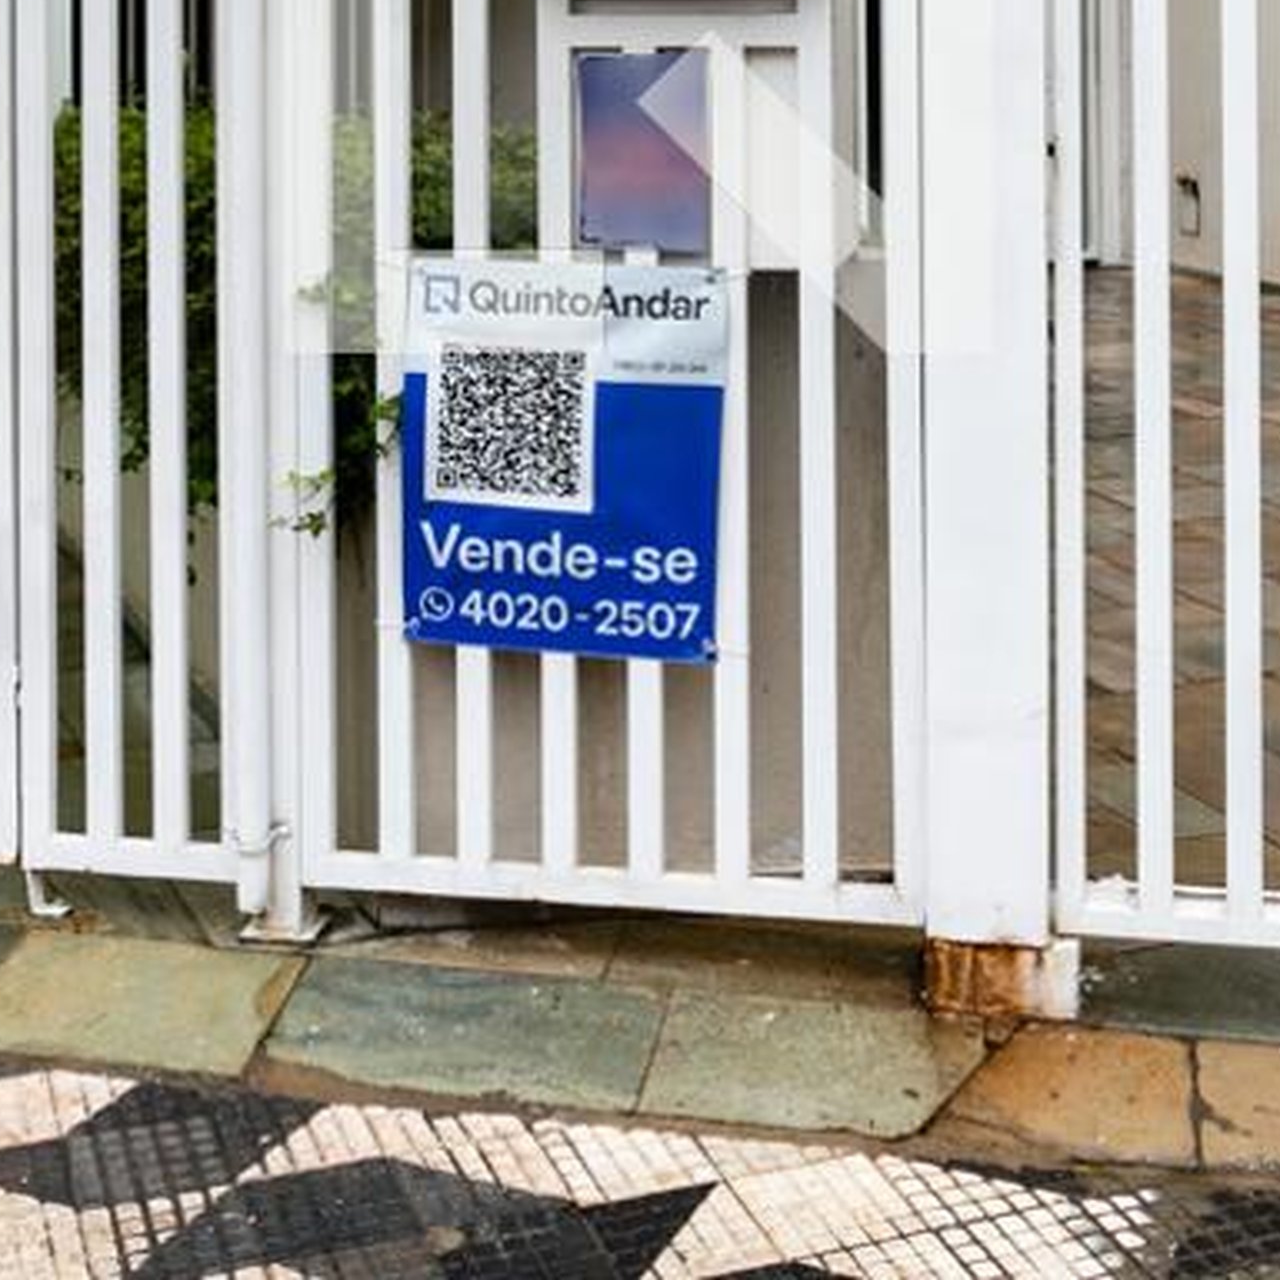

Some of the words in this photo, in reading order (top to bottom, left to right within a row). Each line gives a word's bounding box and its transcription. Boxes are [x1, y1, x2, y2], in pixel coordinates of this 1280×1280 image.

[468, 280, 711, 322] QuintoAndar
[421, 522, 699, 584] Vende-se
[460, 590, 701, 640] 4020-2507
